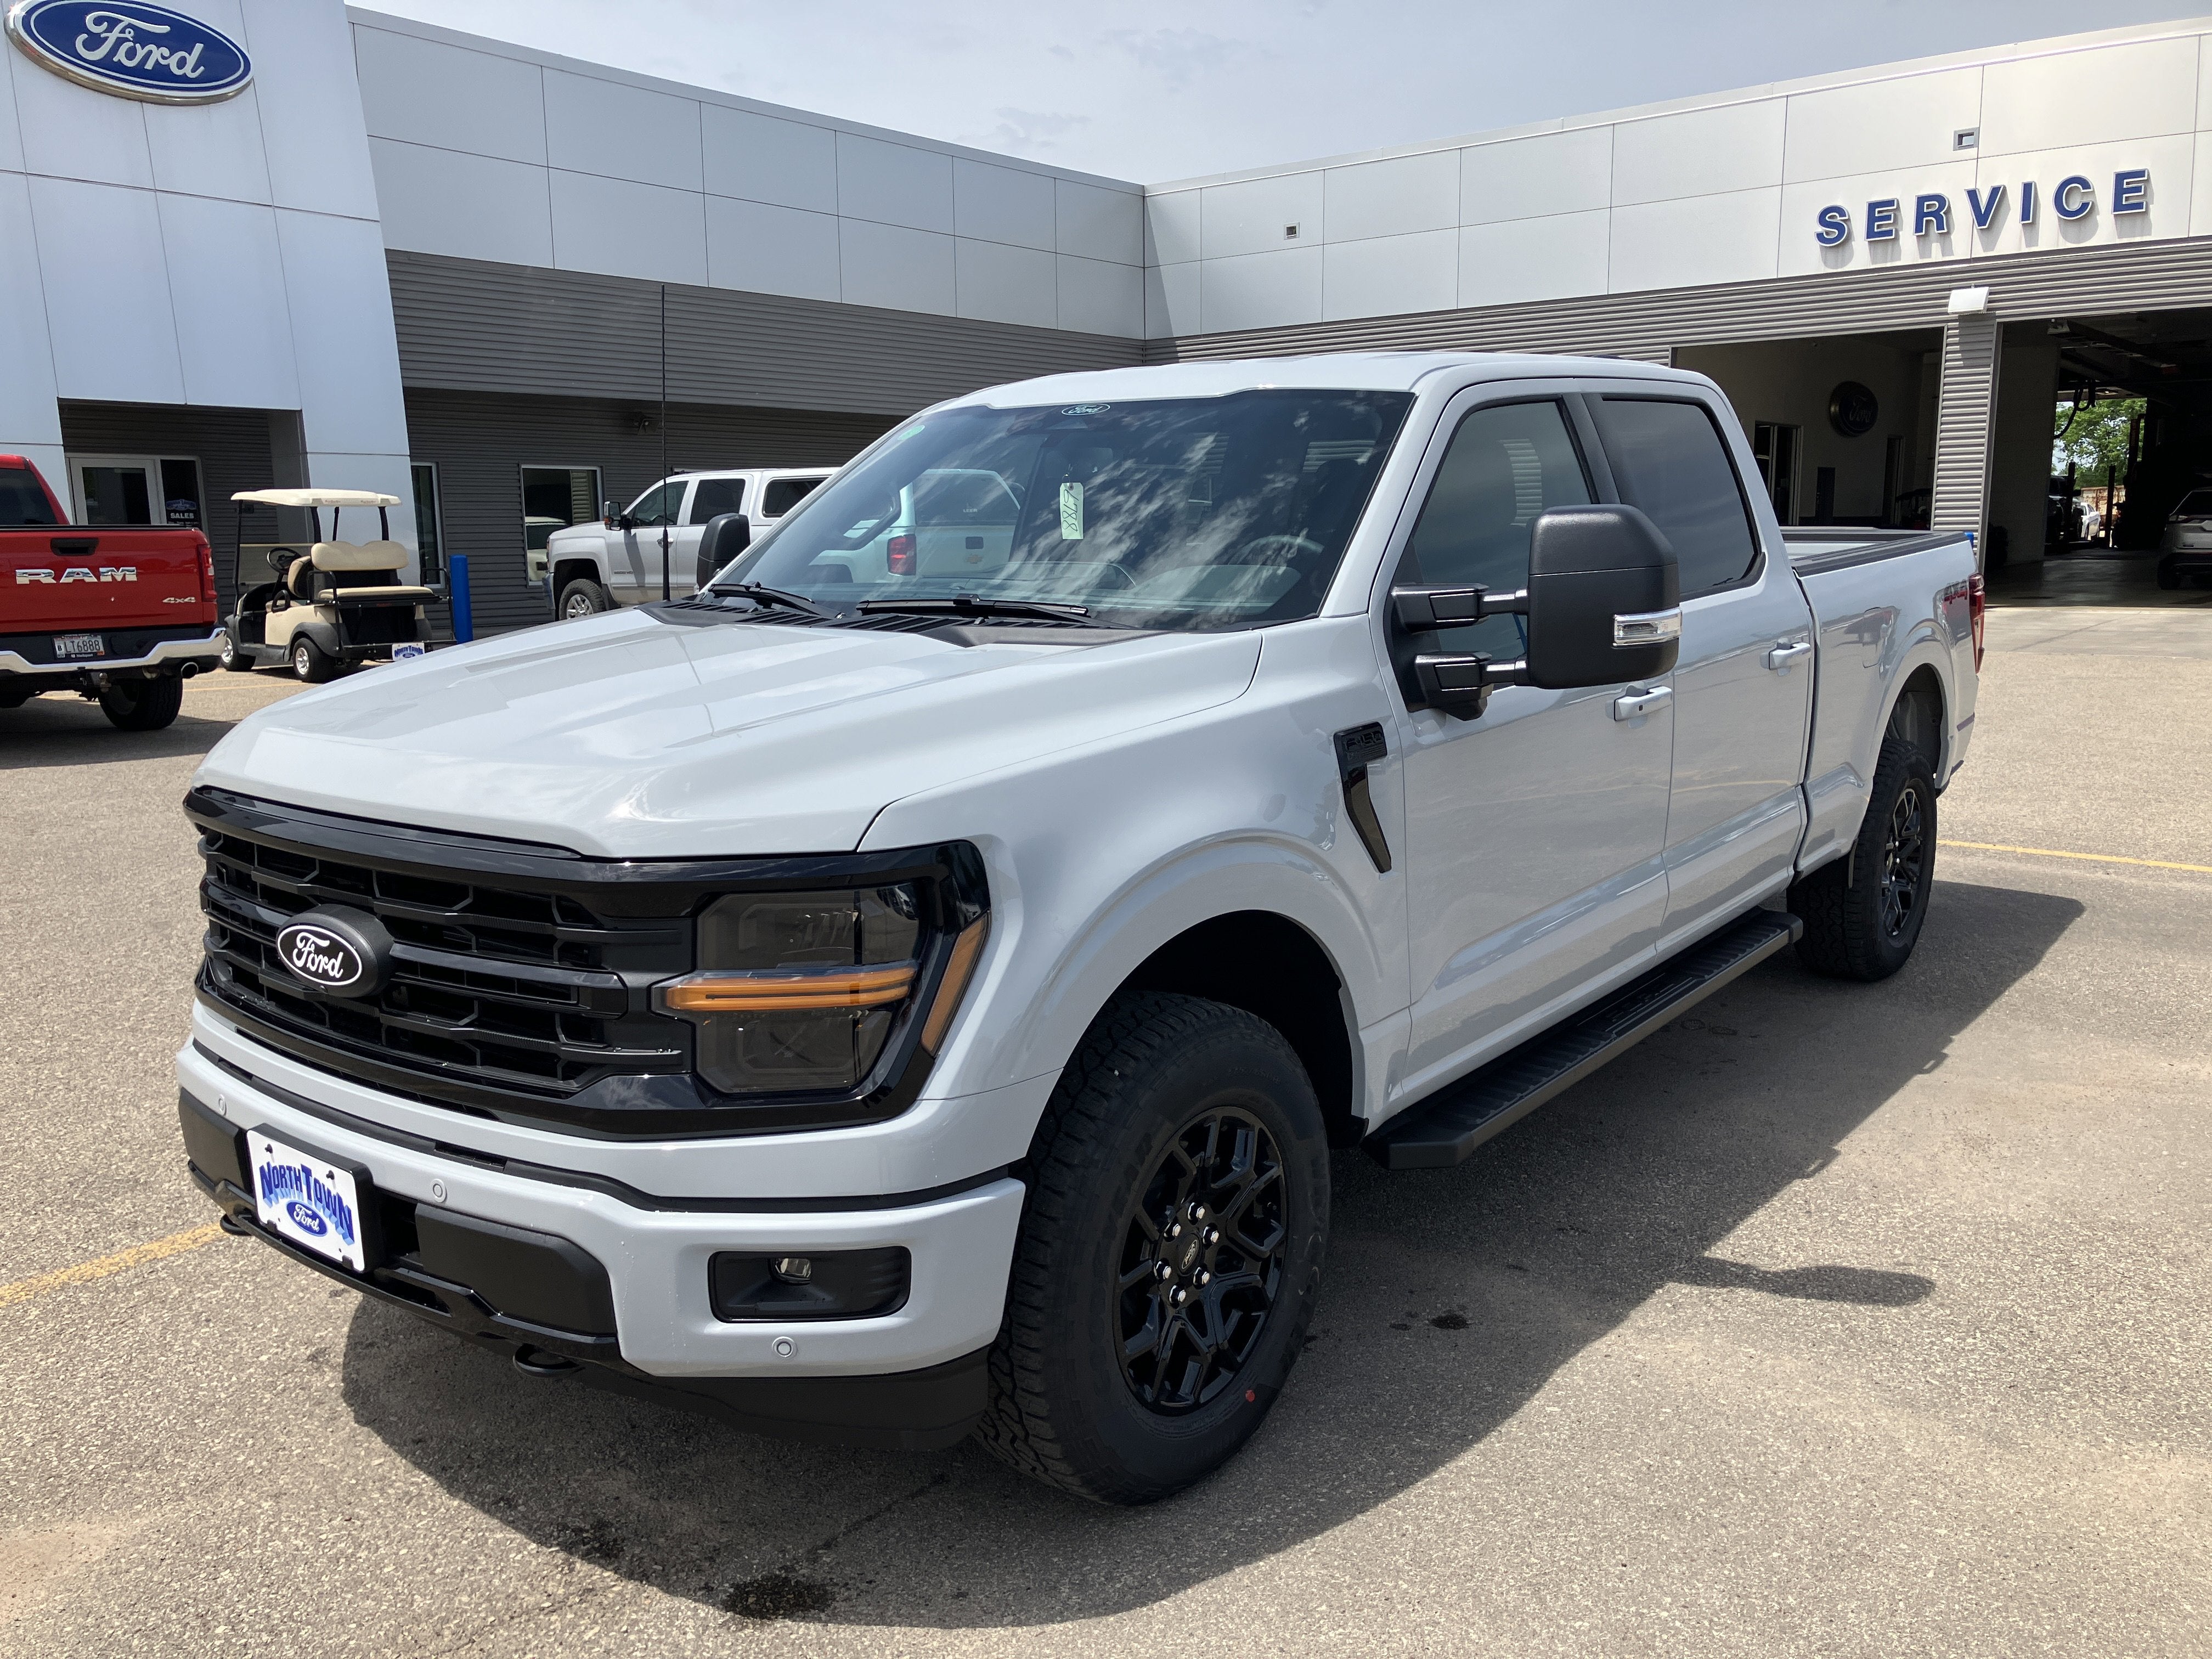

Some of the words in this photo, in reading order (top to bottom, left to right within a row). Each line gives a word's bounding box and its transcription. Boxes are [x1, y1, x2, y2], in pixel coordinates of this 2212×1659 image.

[76, 11, 205, 78] Ford
[1814, 168, 2149, 247] SERVICE
[1068, 404, 1103, 414] Ford
[1062, 489, 1080, 532] 6788
[15, 567, 137, 584] RAM
[292, 932, 344, 978] Ford
[290, 1203, 320, 1233] Ford
